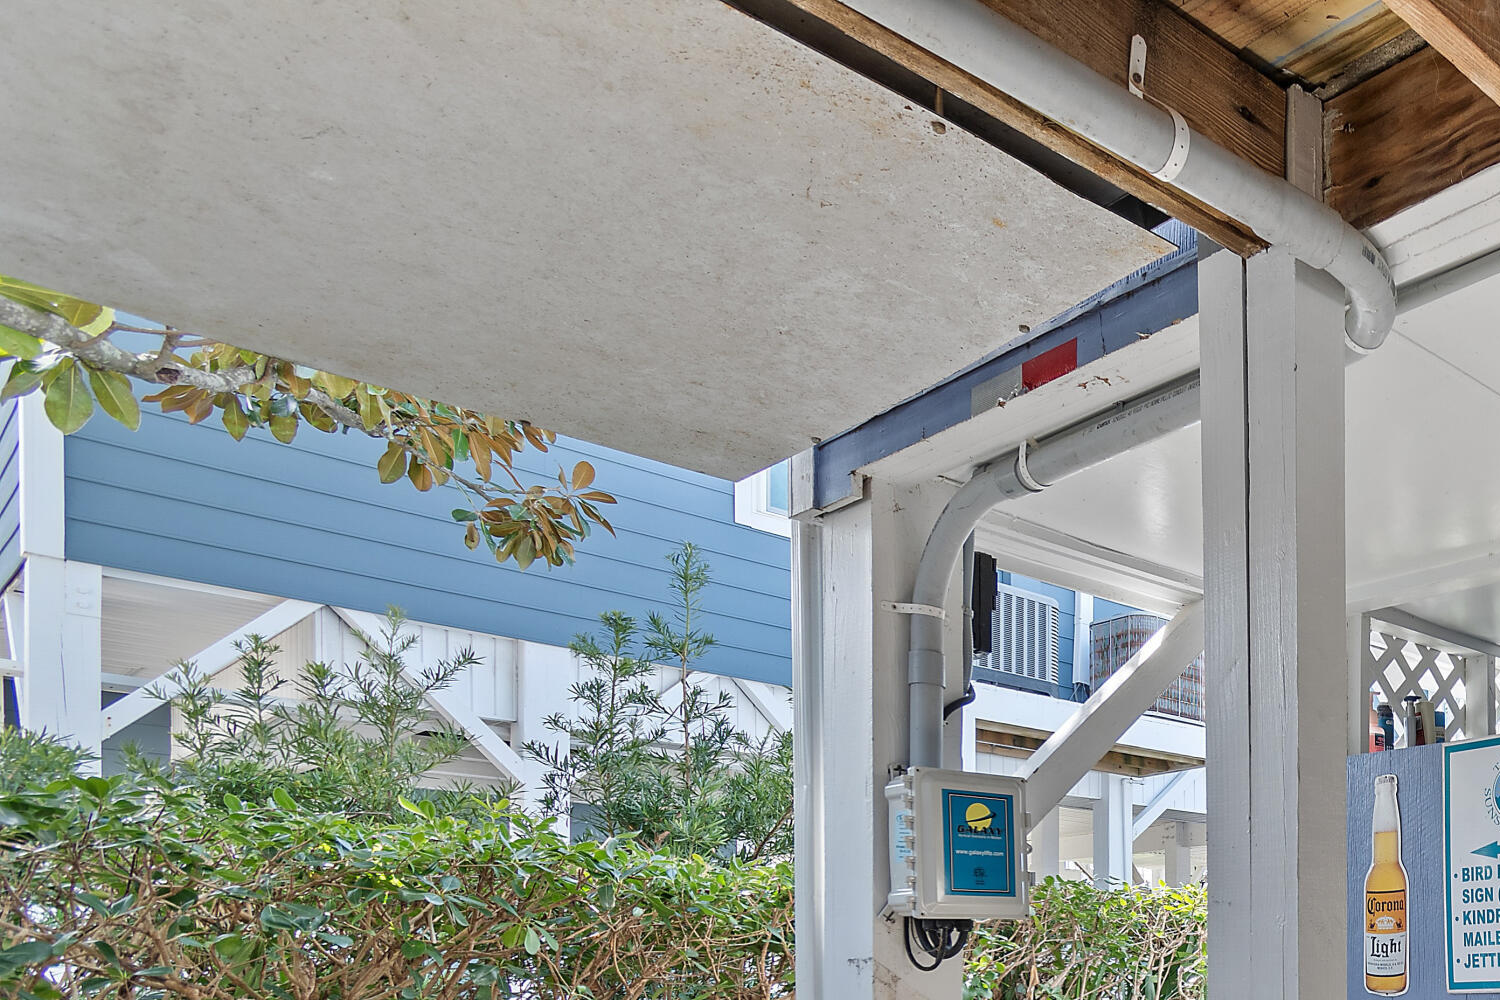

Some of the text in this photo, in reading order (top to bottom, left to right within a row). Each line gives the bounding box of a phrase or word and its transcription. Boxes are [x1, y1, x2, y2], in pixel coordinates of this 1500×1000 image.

[957, 825, 1003, 835] GALAXY
[1461, 865, 1493, 883] BIRD
[1462, 887, 1494, 904] SIGN
[1367, 897, 1404, 917] Corona
[1370, 936, 1402, 958] Light
